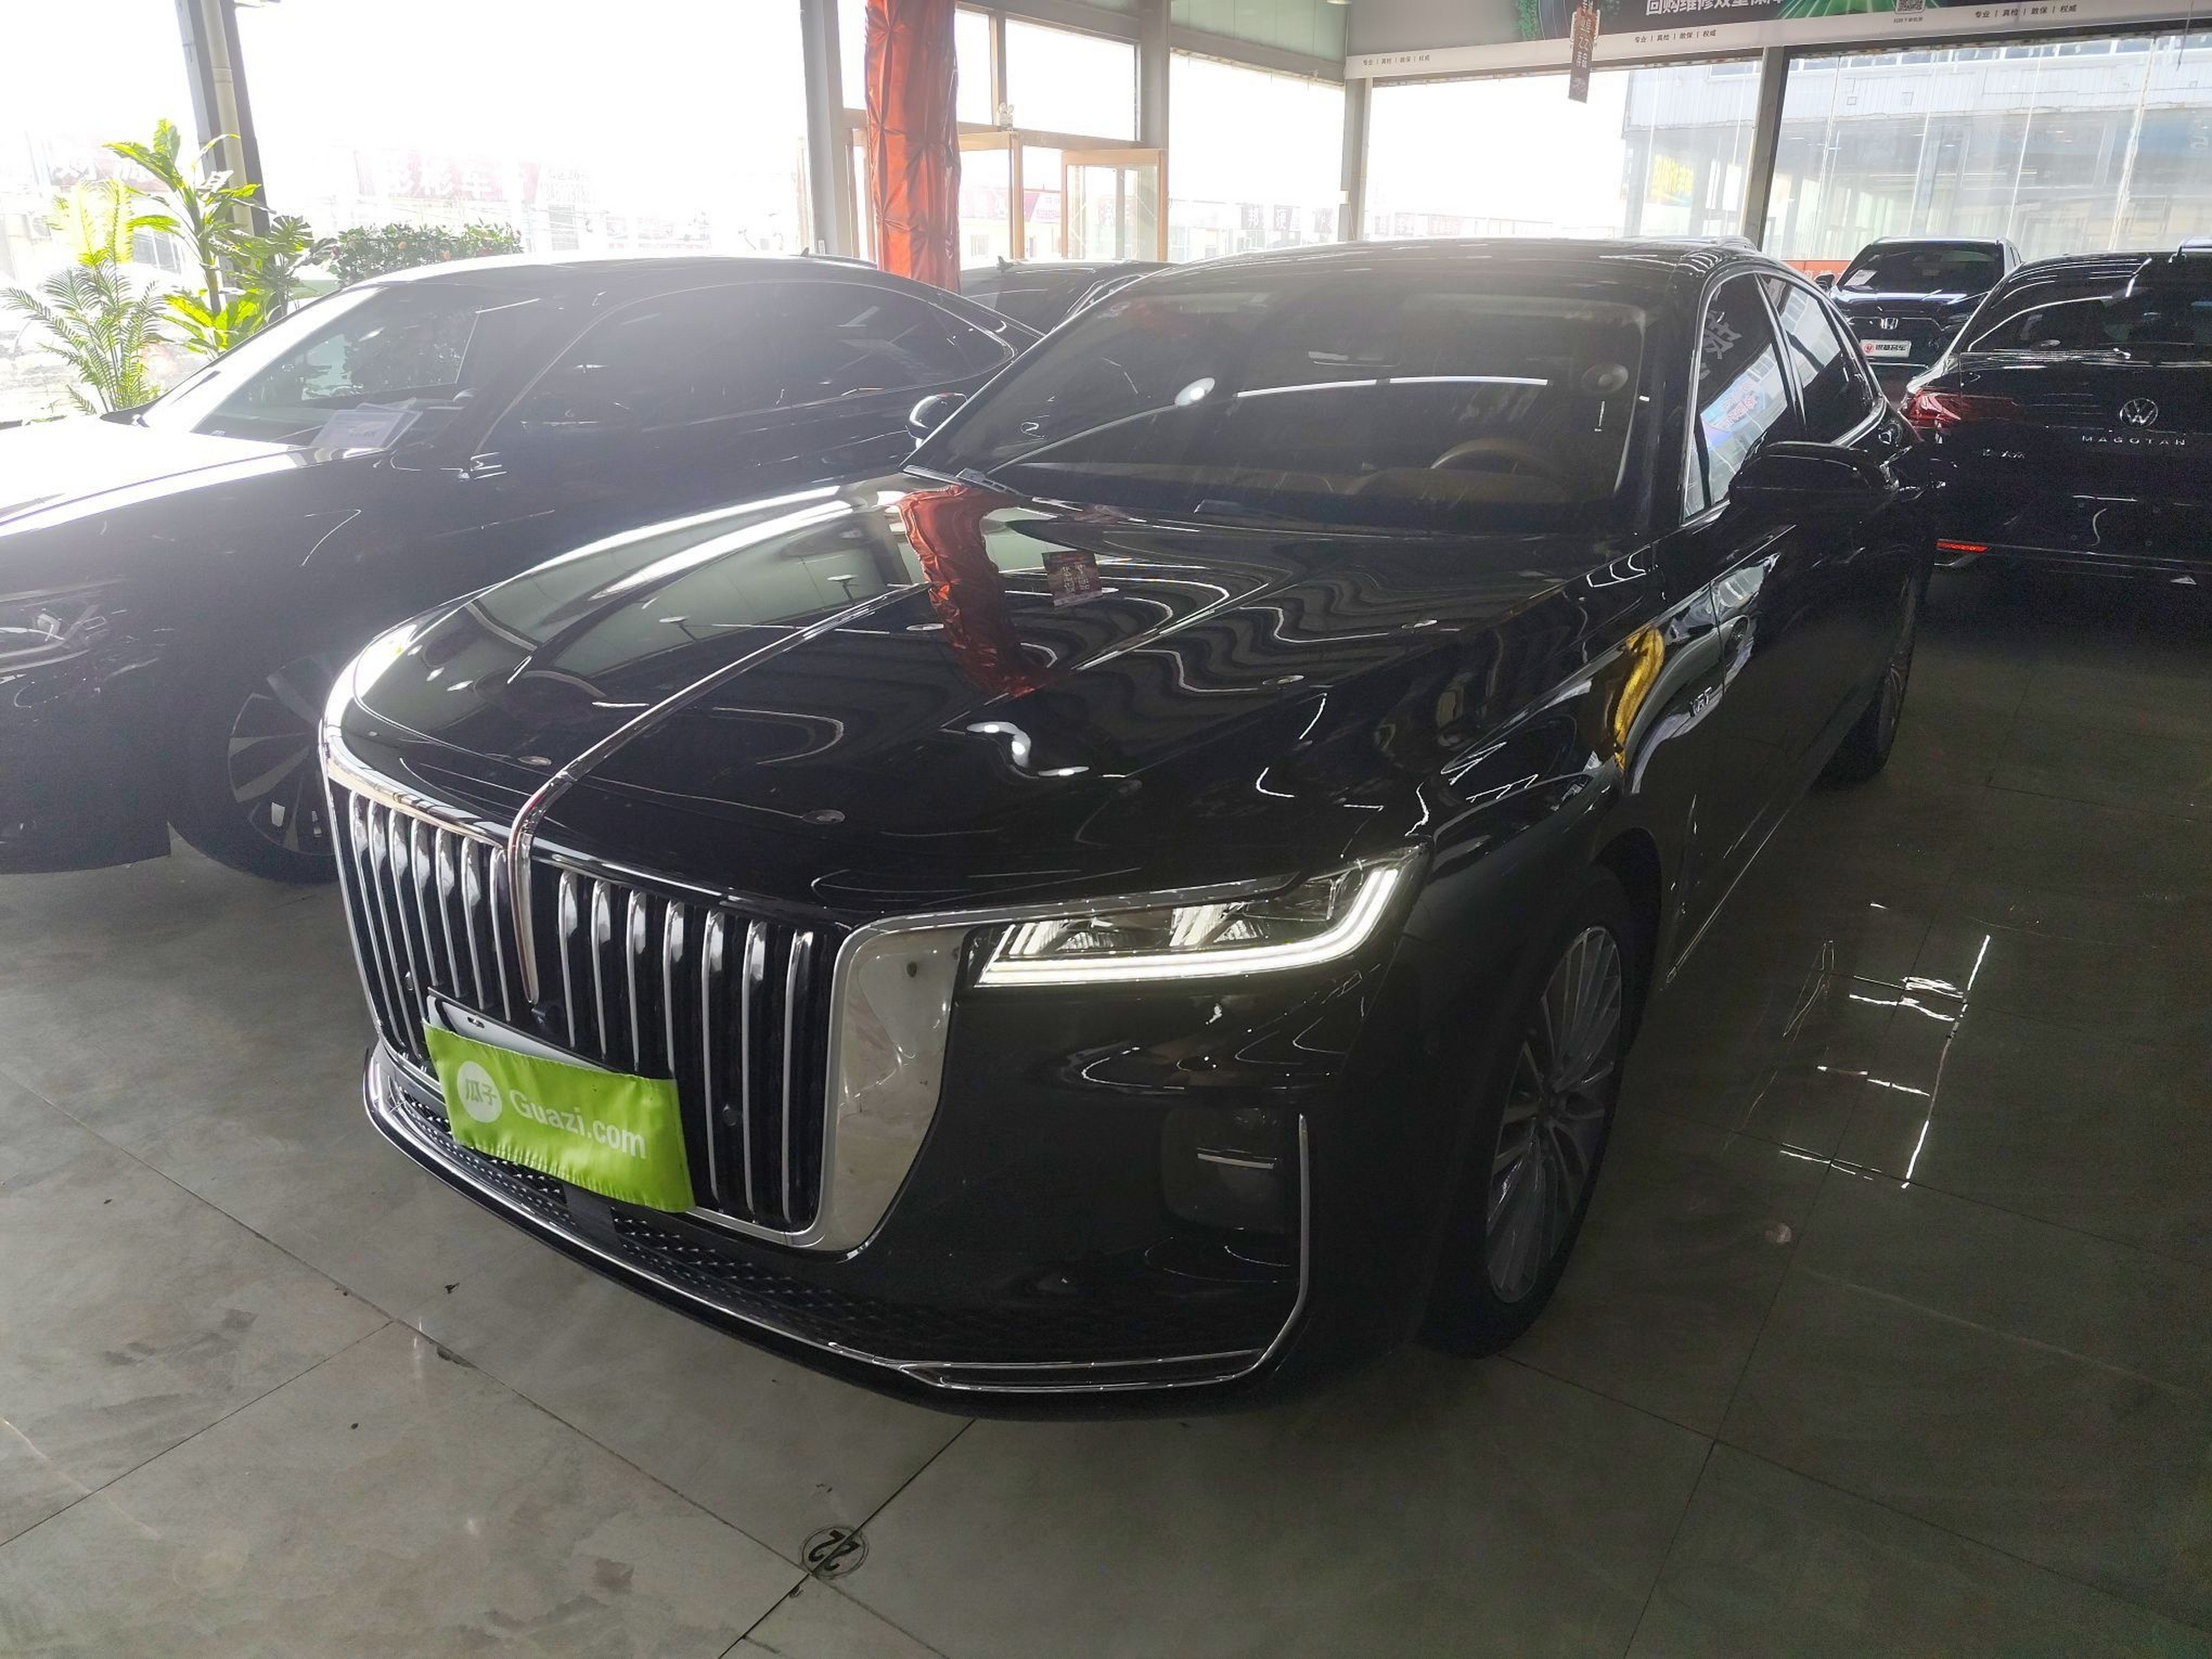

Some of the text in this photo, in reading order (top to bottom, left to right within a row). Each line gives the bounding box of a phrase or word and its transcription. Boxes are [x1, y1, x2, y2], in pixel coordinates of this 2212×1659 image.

[1975, 10, 1990, 18] 专业
[2060, 5, 2078, 13] 权威
[2082, 435, 2186, 446] MAGOTAN
[466, 1080, 647, 1159] 瓜子 Guazi.com
